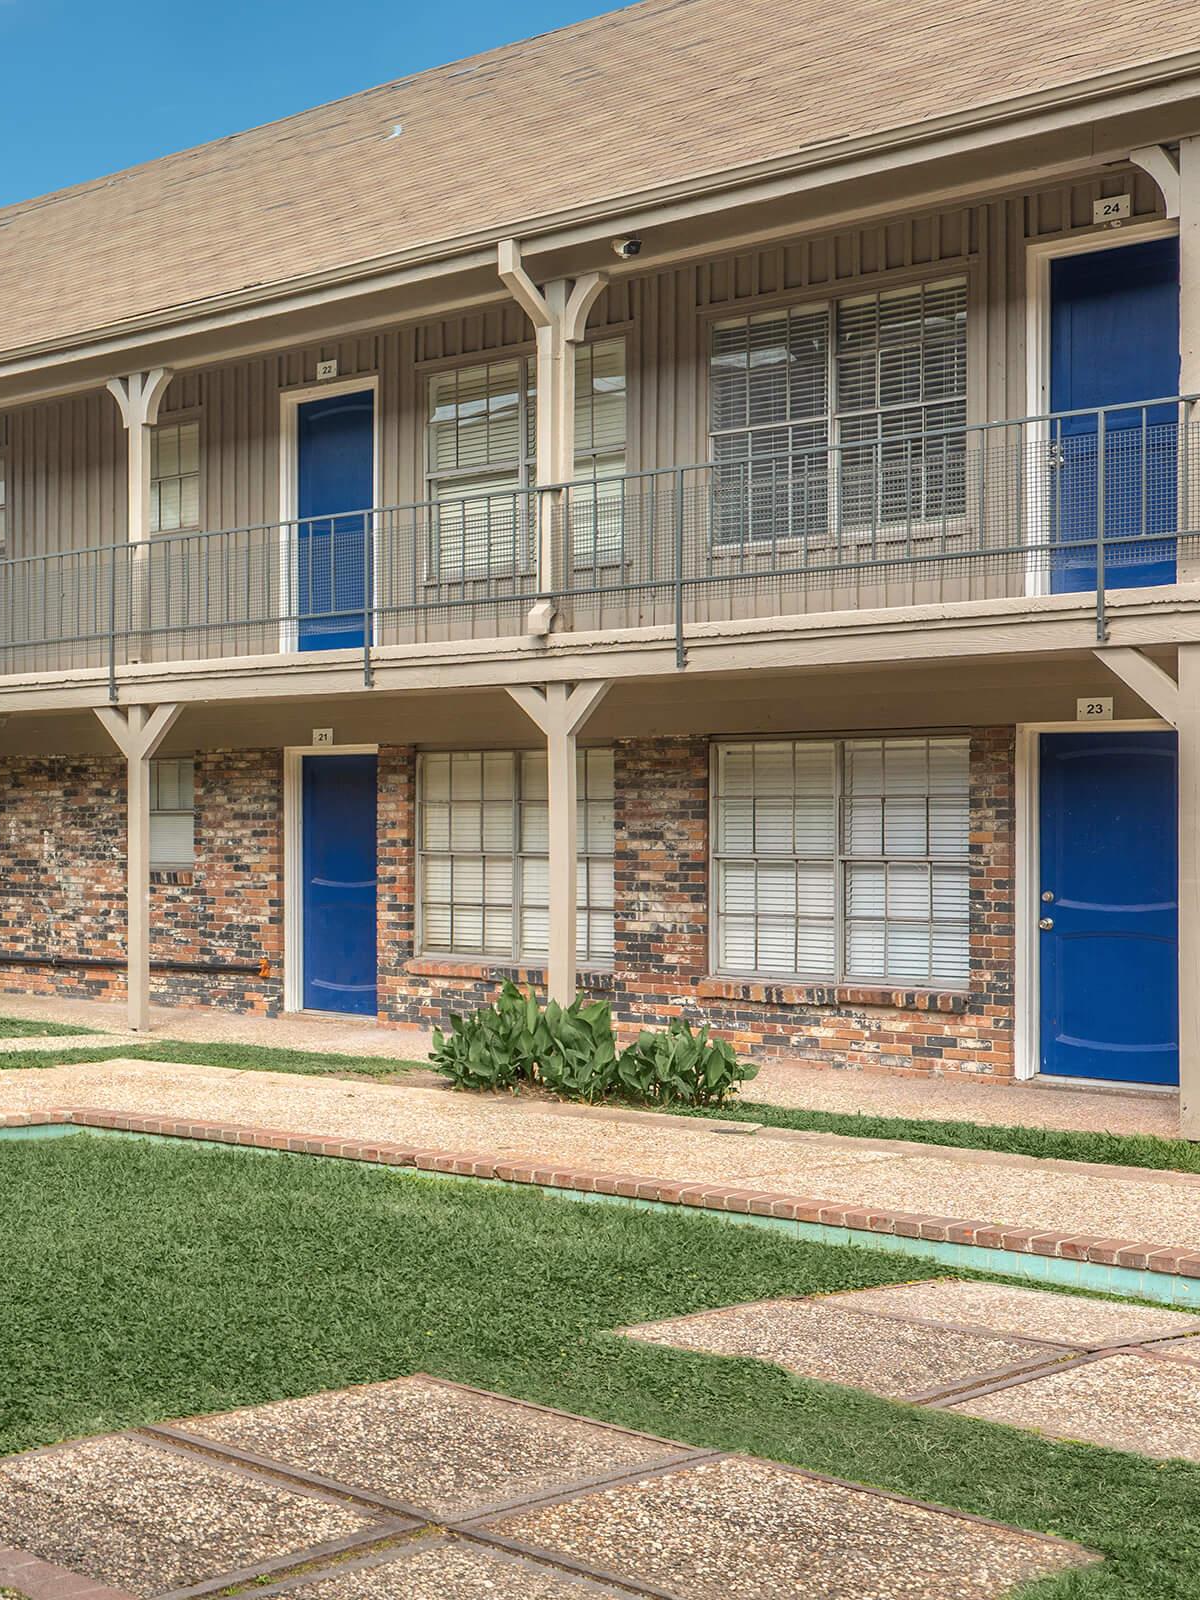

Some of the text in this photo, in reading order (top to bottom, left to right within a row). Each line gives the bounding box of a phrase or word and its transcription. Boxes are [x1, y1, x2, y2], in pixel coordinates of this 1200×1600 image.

[1103, 202, 1120, 215] 24
[322, 365, 332, 374] 22
[1087, 703, 1104, 714] 23
[318, 733, 328, 741] 21
